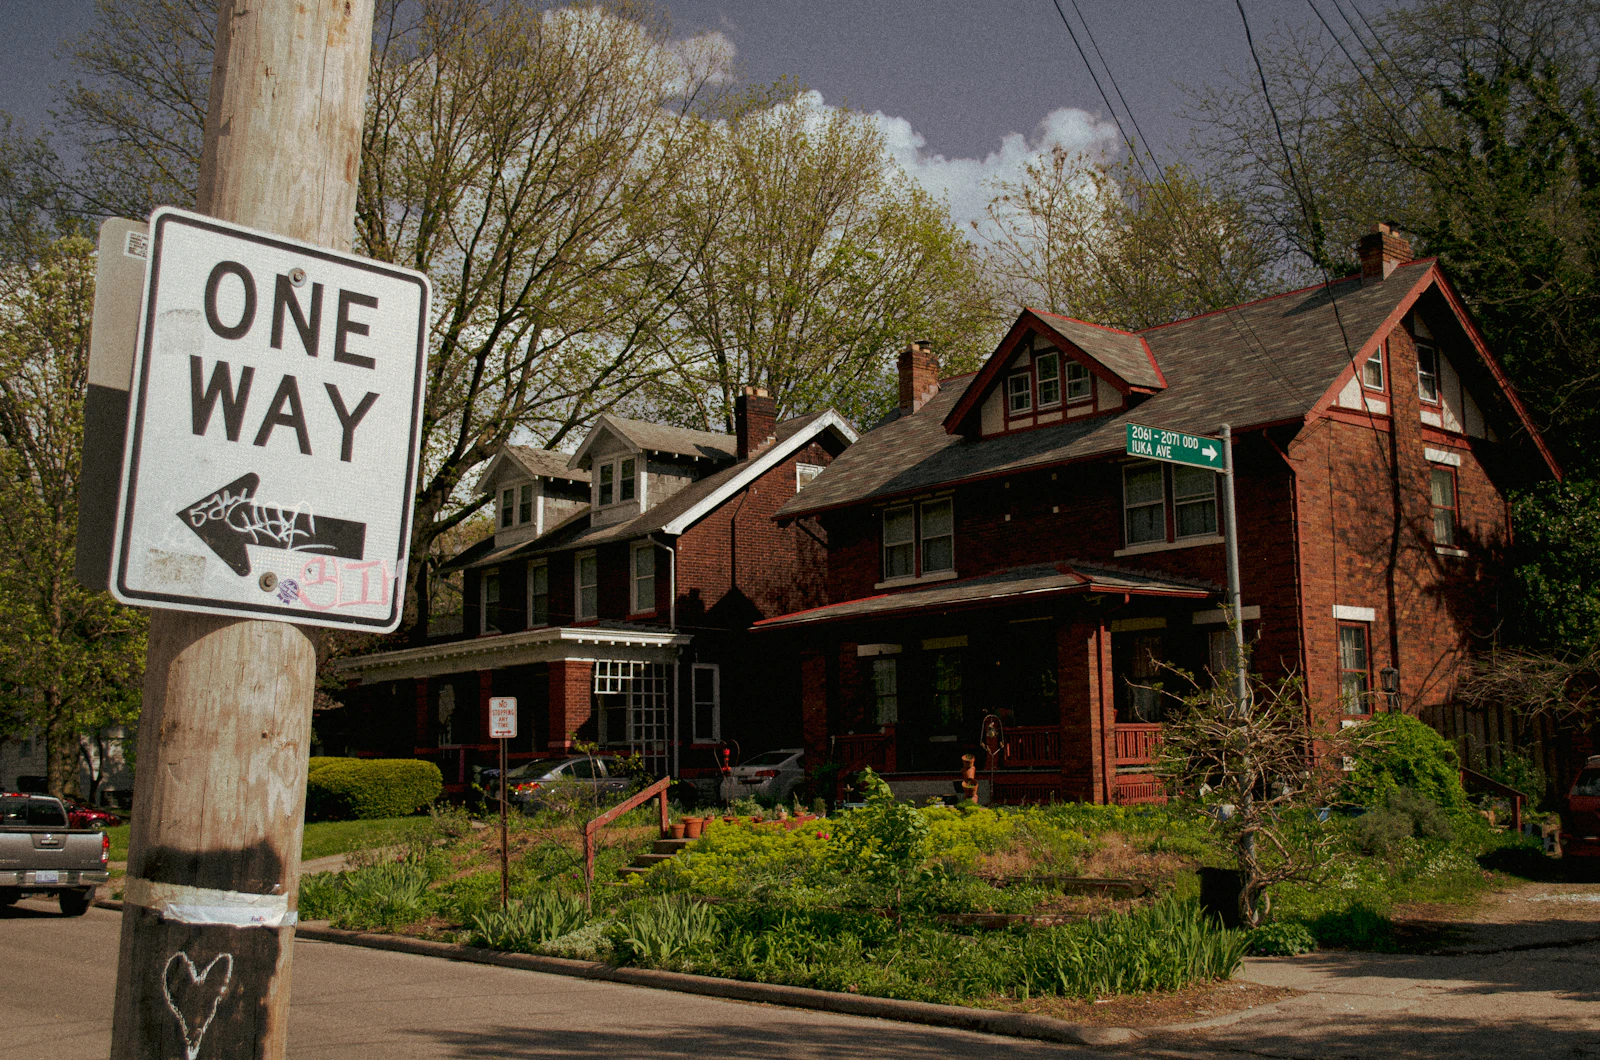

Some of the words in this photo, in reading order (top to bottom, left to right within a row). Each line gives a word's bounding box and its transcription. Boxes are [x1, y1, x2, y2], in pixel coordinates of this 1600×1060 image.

[204, 260, 379, 370] ONE
[190, 354, 380, 463] WAY
[1132, 425, 1152, 441] 2061
[1161, 431, 1180, 446] 2071
[1182, 436, 1199, 449] ODD
[1132, 440, 1153, 455] IUKA
[1155, 444, 1172, 458] AVE
